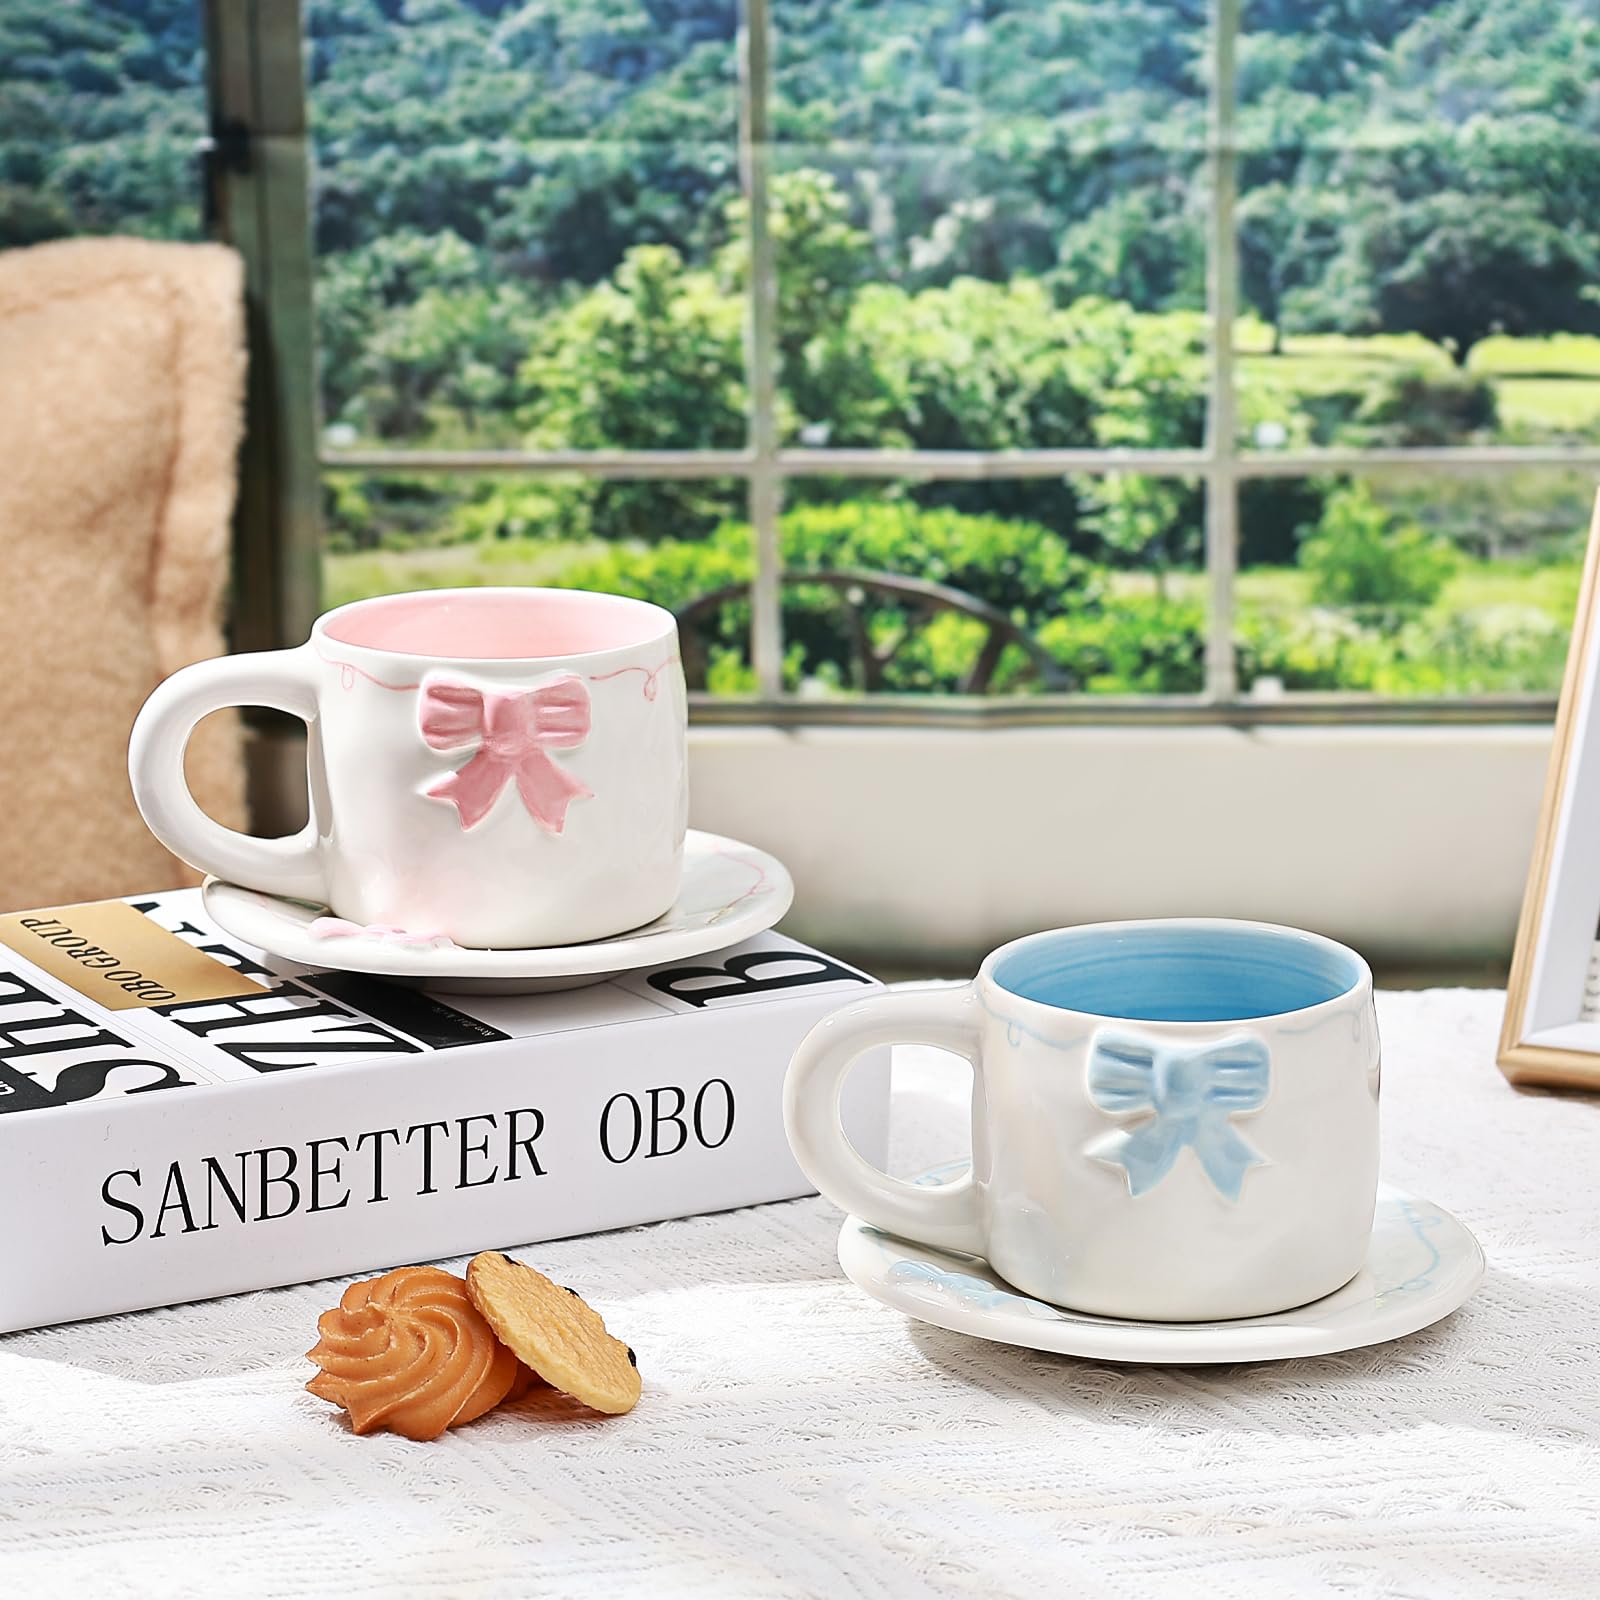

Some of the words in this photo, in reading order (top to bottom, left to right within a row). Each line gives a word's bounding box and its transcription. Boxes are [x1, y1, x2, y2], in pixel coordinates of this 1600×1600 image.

[19, 917, 121, 970] GROUP
[103, 969, 177, 1002] OBO
[100, 1107, 549, 1247] SANBETTER
[598, 1077, 736, 1166] OBO
